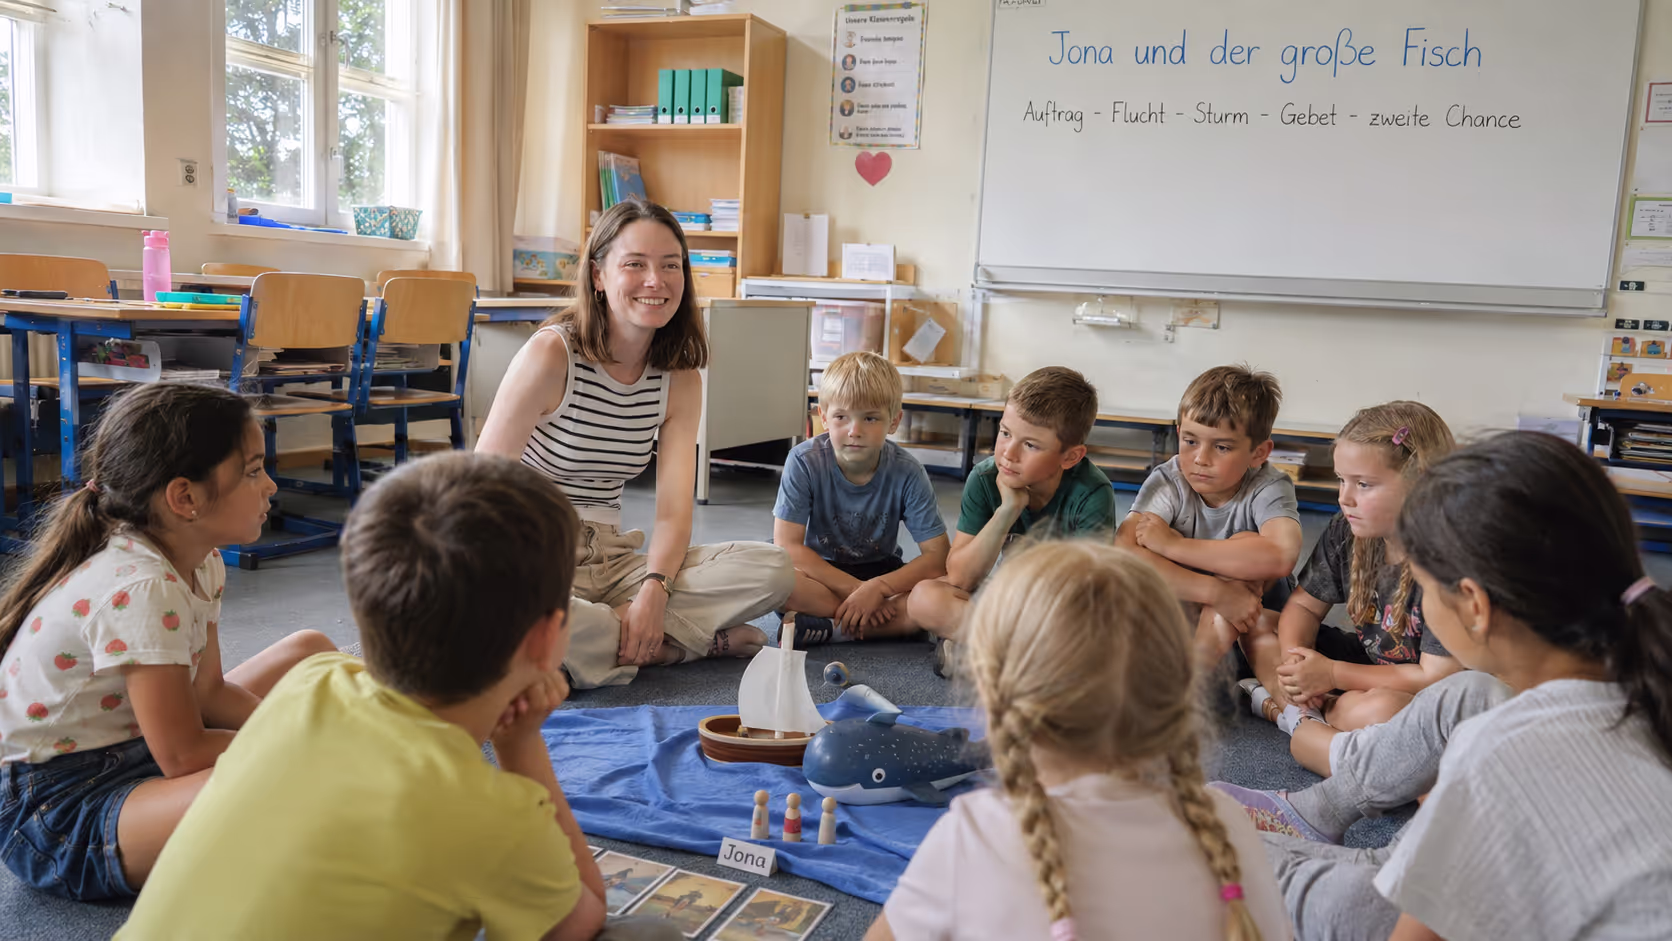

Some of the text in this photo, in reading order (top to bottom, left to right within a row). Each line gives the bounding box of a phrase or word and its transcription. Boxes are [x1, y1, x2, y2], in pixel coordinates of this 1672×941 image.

[1048, 27, 1482, 85] Jona und der große Fisch
[1022, 100, 1084, 134] Auftrag
[1111, 100, 1166, 124] Flucht
[1193, 101, 1249, 125] Sturm
[1280, 102, 1338, 126] Gebet
[1368, 104, 1431, 128] zweite
[1445, 103, 1522, 129] Chance
[723, 843, 767, 869] Jona
